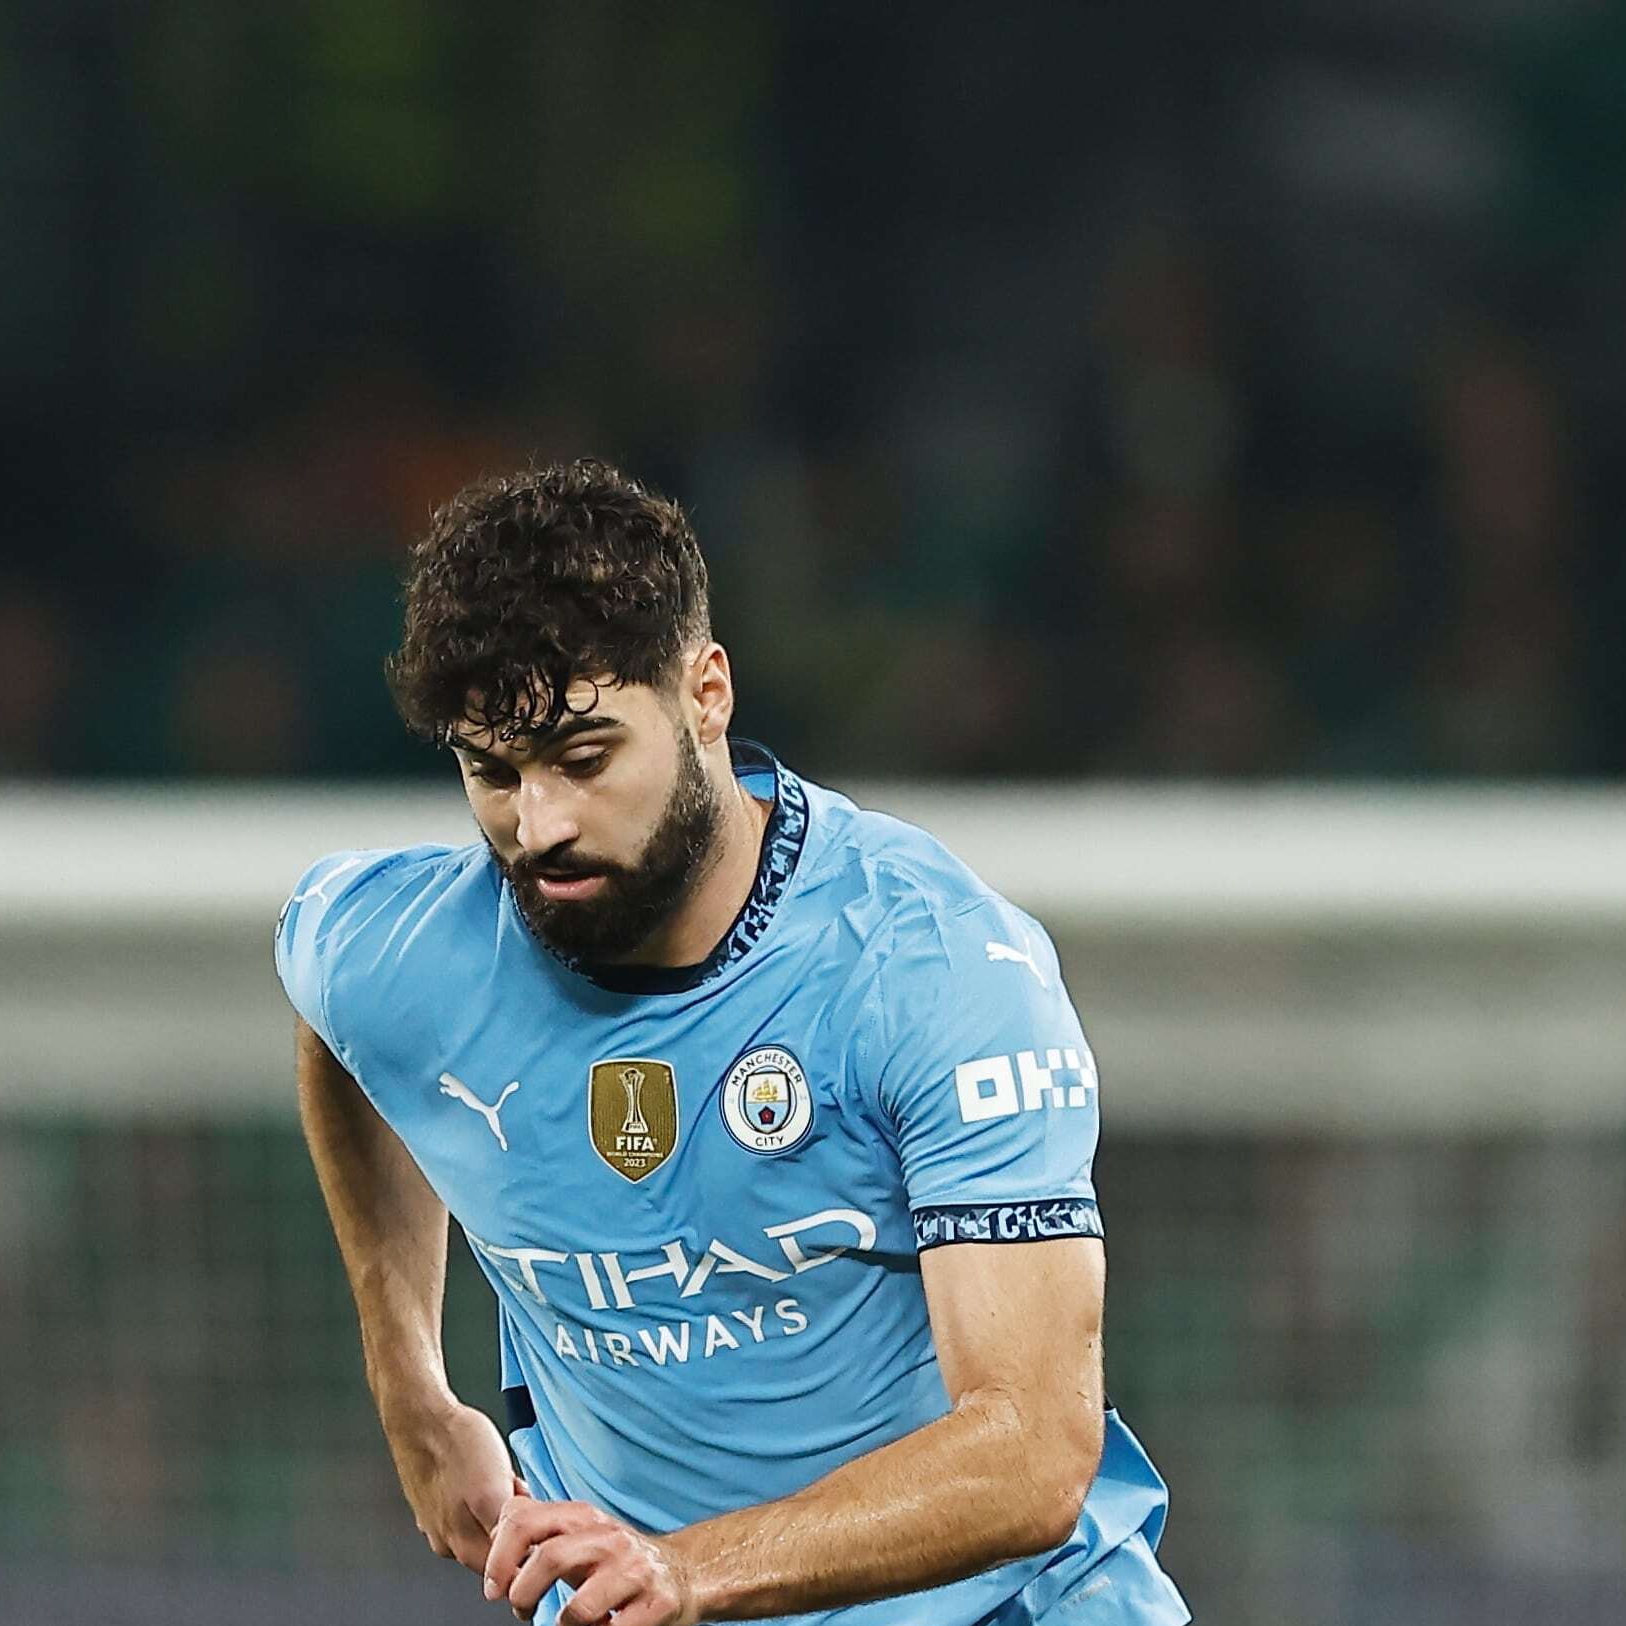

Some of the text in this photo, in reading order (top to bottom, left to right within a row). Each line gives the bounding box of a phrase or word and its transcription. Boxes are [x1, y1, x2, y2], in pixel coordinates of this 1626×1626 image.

[731, 1053, 803, 1086] MANCHESTER
[615, 1135, 655, 1152] FIFA
[755, 1135, 784, 1147] CITY
[624, 1157, 646, 1168] 2023
[473, 1208, 878, 1310] TIHAD
[555, 1299, 809, 1367] AIRWAYS
